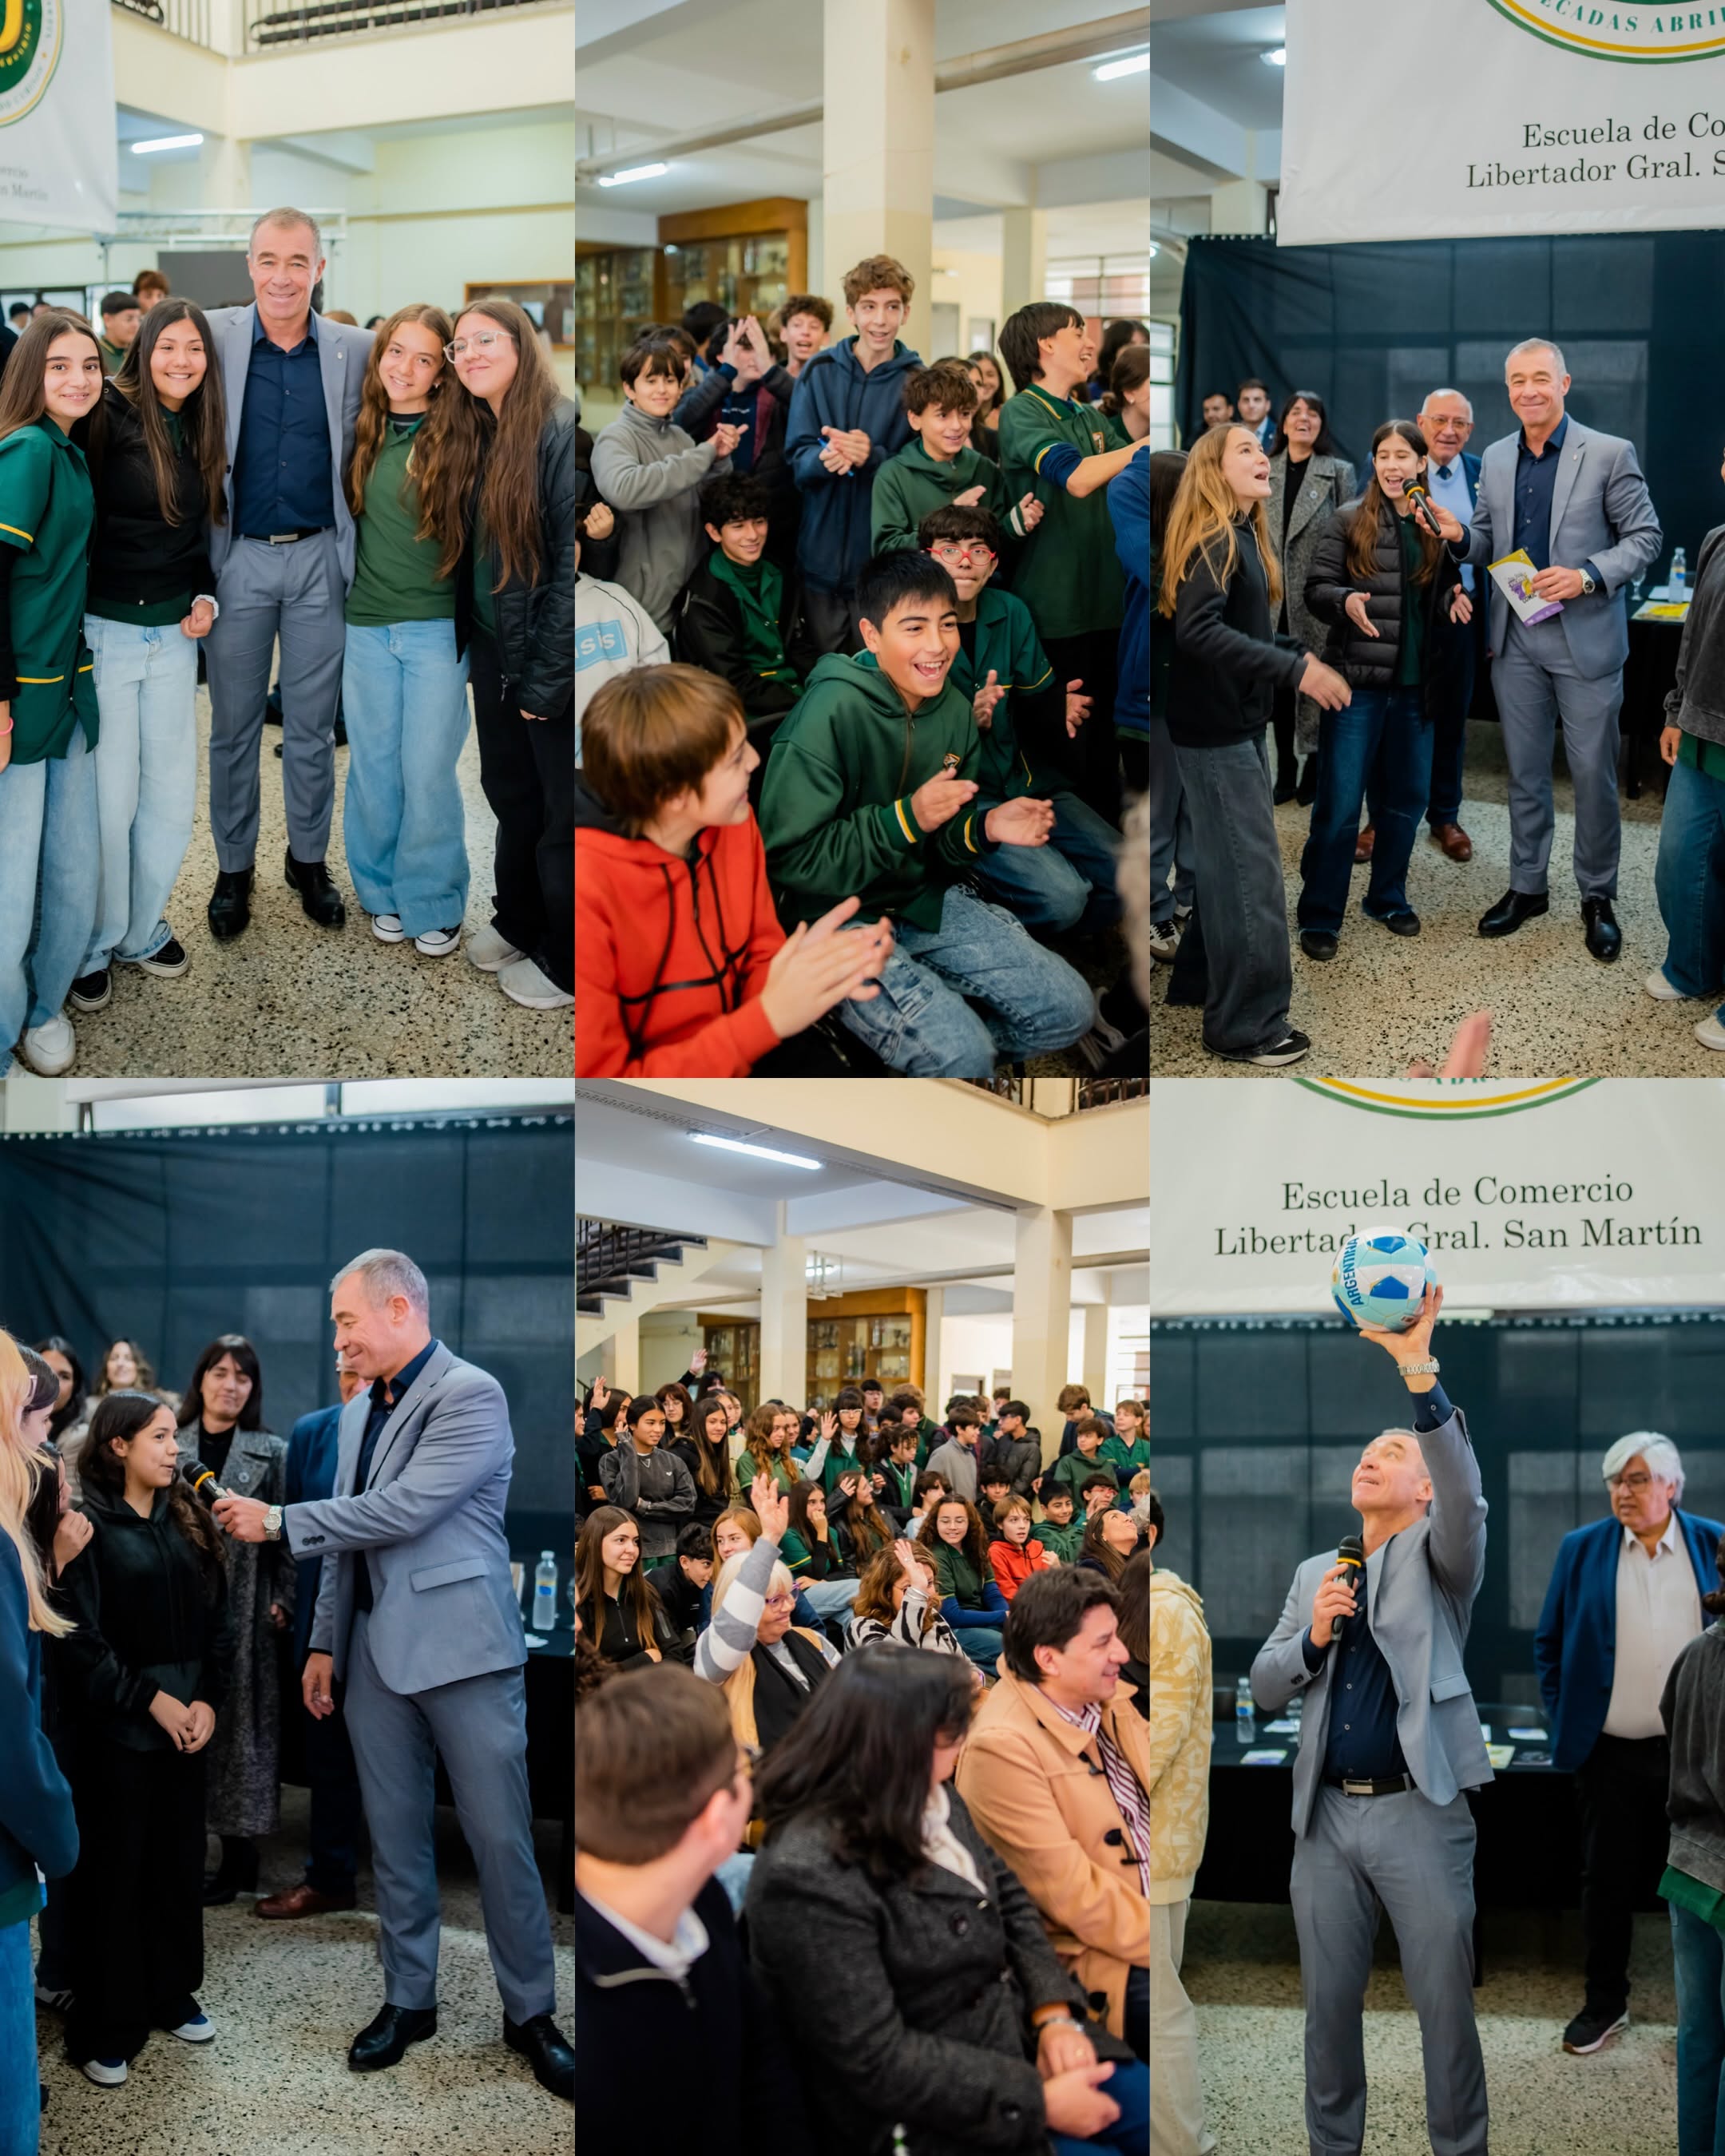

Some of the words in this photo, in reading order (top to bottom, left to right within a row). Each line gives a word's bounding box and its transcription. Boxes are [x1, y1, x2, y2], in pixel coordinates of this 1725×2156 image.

[1522, 118, 1632, 149] Escuela
[1643, 115, 1676, 141] de
[1687, 112, 1725, 138] Co
[1466, 157, 1616, 188] Libertador
[1627, 152, 1700, 180] Gral.
[1281, 1179, 1410, 1211] Escuela
[1423, 1178, 1460, 1207] de
[1474, 1174, 1633, 1205] Comercio
[1214, 1224, 1356, 1256] Libertad
[1504, 1219, 1569, 1249] San
[1580, 1216, 1703, 1247] Martín
[1342, 1236, 1365, 1307] ARGENTINA
